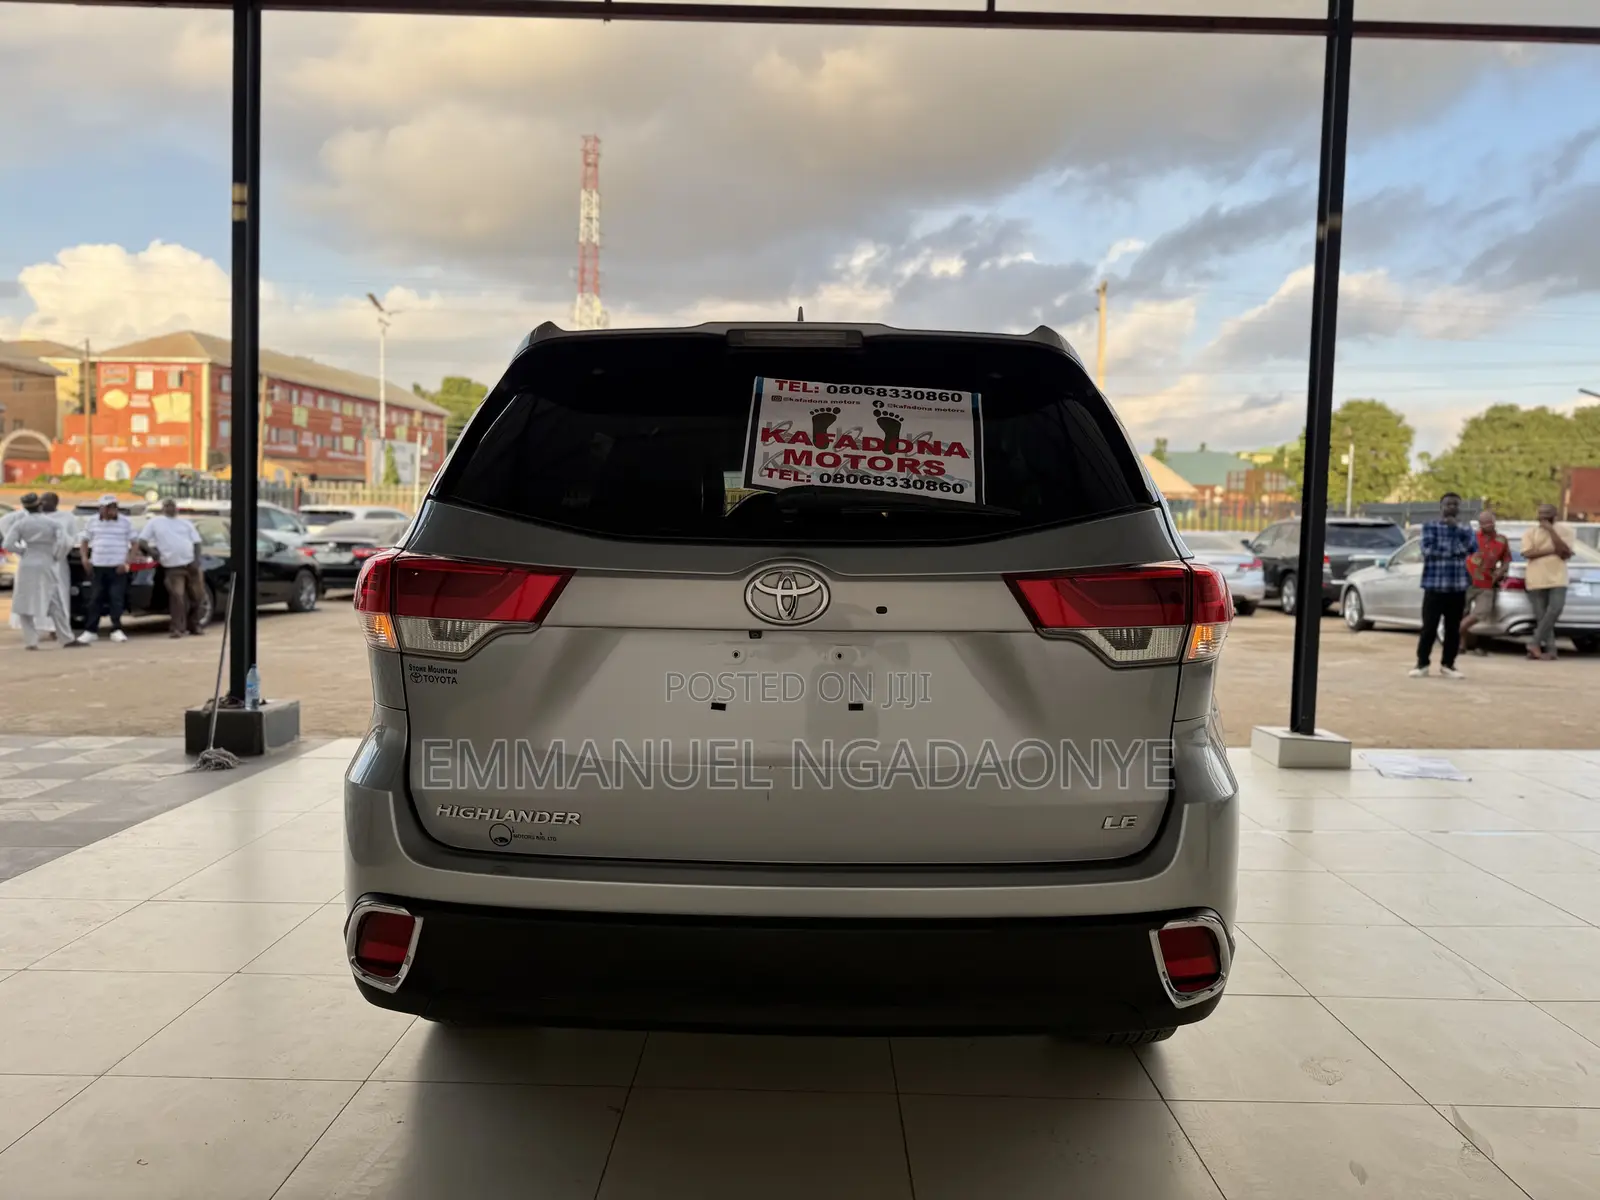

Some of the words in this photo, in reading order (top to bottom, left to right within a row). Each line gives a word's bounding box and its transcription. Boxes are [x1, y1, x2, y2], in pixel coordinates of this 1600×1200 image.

[775, 379, 820, 394] TEL:
[826, 385, 963, 402] 08068330860
[760, 427, 970, 459] KAFADONA
[783, 448, 947, 477] MOTORS
[765, 467, 812, 483] TEL:
[819, 473, 965, 494] 08068330860
[423, 674, 458, 684] TOYOTA
[435, 804, 582, 826] HIGHLANDER
[1101, 815, 1138, 830] LE
